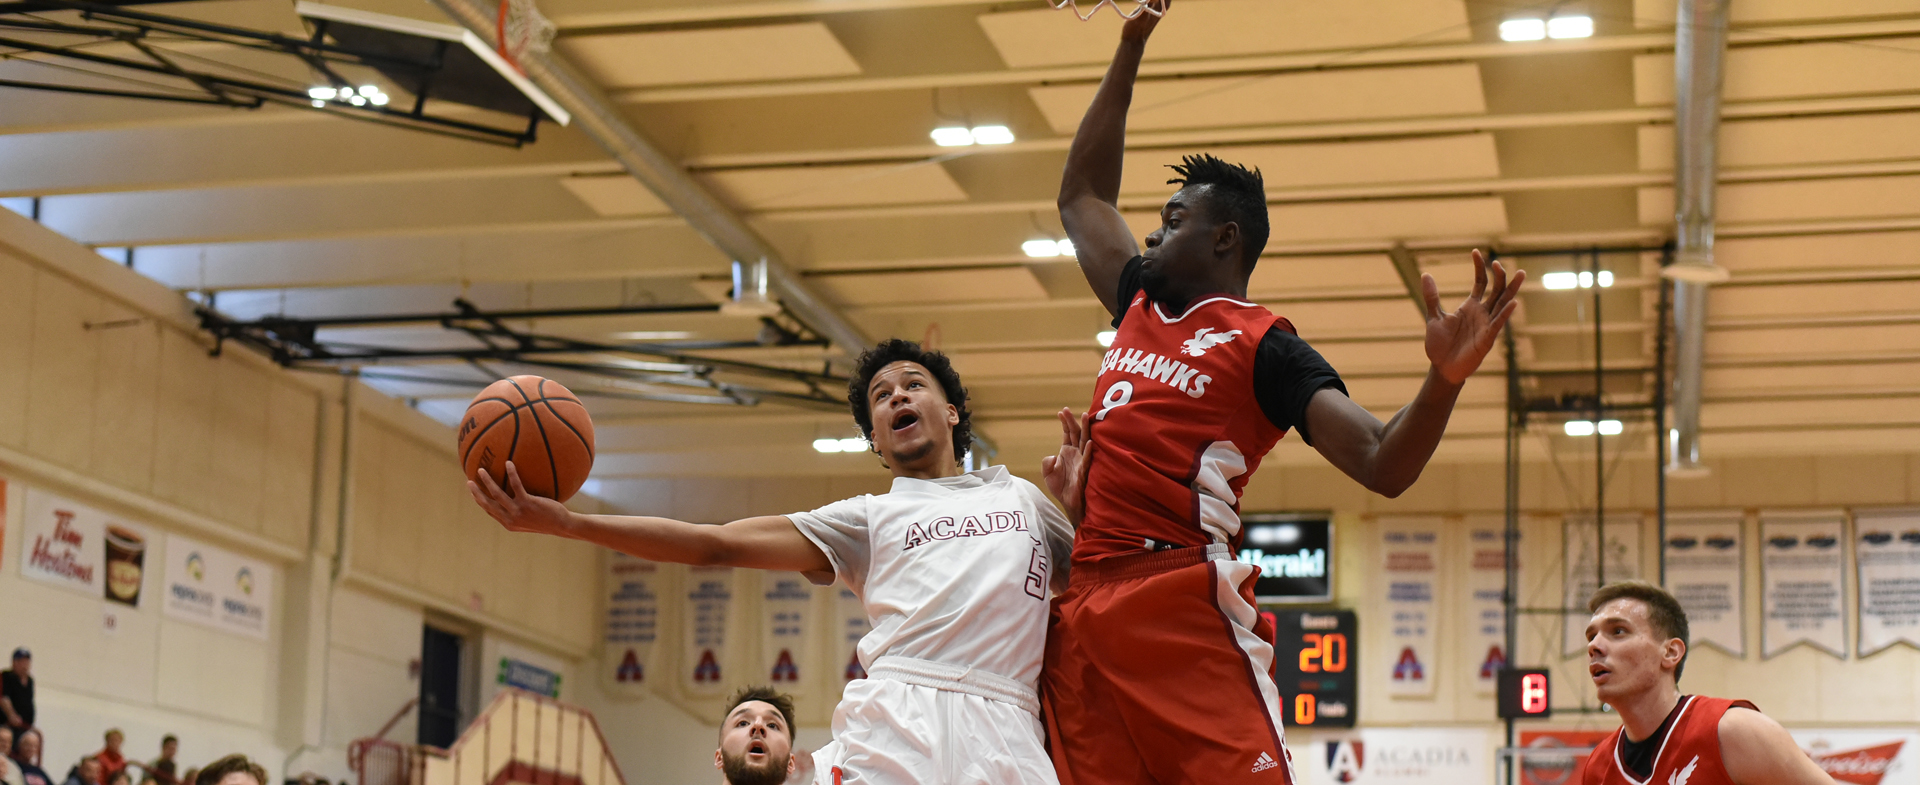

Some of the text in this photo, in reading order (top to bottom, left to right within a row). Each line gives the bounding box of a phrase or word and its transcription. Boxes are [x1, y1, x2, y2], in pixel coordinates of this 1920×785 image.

[1095, 380, 1134, 420] 9
[53, 509, 83, 548] Tim
[903, 511, 1042, 550] ACADI
[29, 533, 94, 585] Hortons
[1024, 547, 1047, 601] 5
[1299, 633, 1347, 673] 20
[1295, 693, 1316, 725] 0
[1251, 761, 1279, 773] adidas
[1374, 746, 1470, 767] ACADIA
